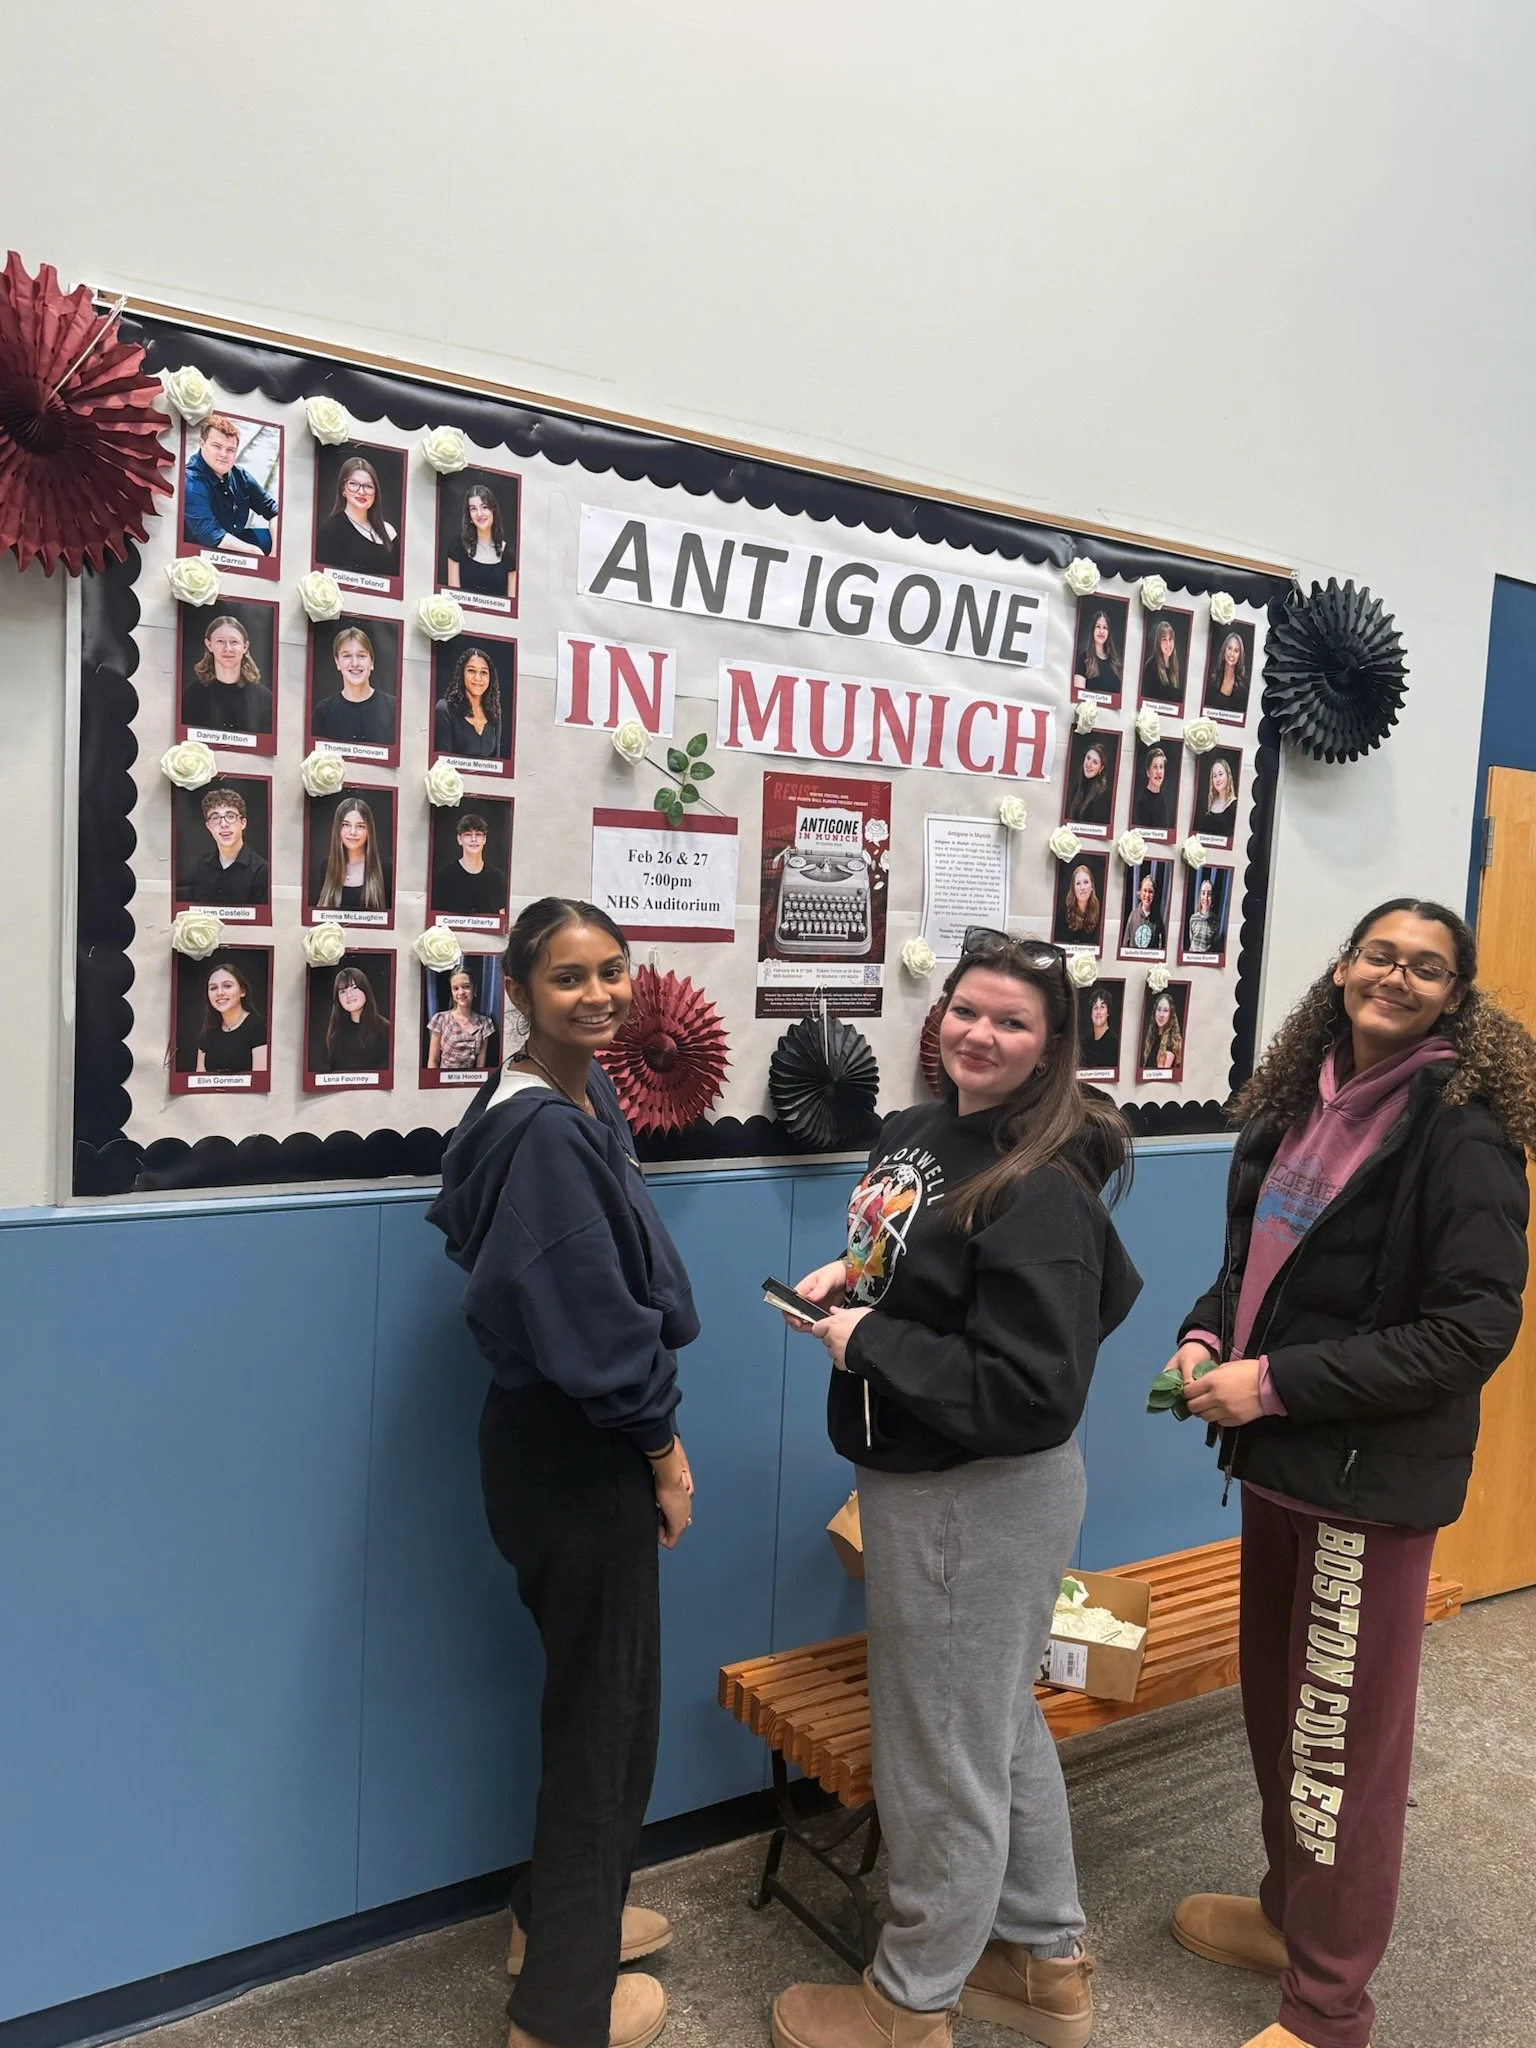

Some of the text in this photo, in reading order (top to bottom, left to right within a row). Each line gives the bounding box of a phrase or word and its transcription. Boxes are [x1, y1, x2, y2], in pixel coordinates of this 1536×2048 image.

[209, 554, 247, 566] JJ Carroll
[332, 571, 384, 589] Colleen Toland
[588, 520, 1040, 664] ANTIGONE
[449, 592, 506, 608] Sophia Mousseau
[564, 638, 1050, 780] IN MUNICH
[196, 731, 249, 743] Danny Britton
[323, 743, 384, 757] Thomas Donovan
[446, 758, 498, 770] Adriana Mendes
[800, 817, 860, 836] ANTIGONE
[799, 832, 859, 843] IN MUNICH
[628, 848, 708, 867] Feb 26 & 27
[643, 872, 692, 890] 7:00pm
[606, 894, 721, 912] NHS Auditorium
[198, 908, 250, 917] im Costello
[320, 912, 384, 922] Emma McLaughlin
[443, 917, 494, 927] Connor Flaherty
[197, 1076, 244, 1085] Elin Gorman
[323, 1075, 370, 1085] Lena Fourney
[461, 1073, 482, 1081] Hoops
[880, 1147, 945, 1206] NORWELL
[1306, 1521, 1366, 1688] BOSTON
[1289, 1683, 1350, 1866] COLLEGE
